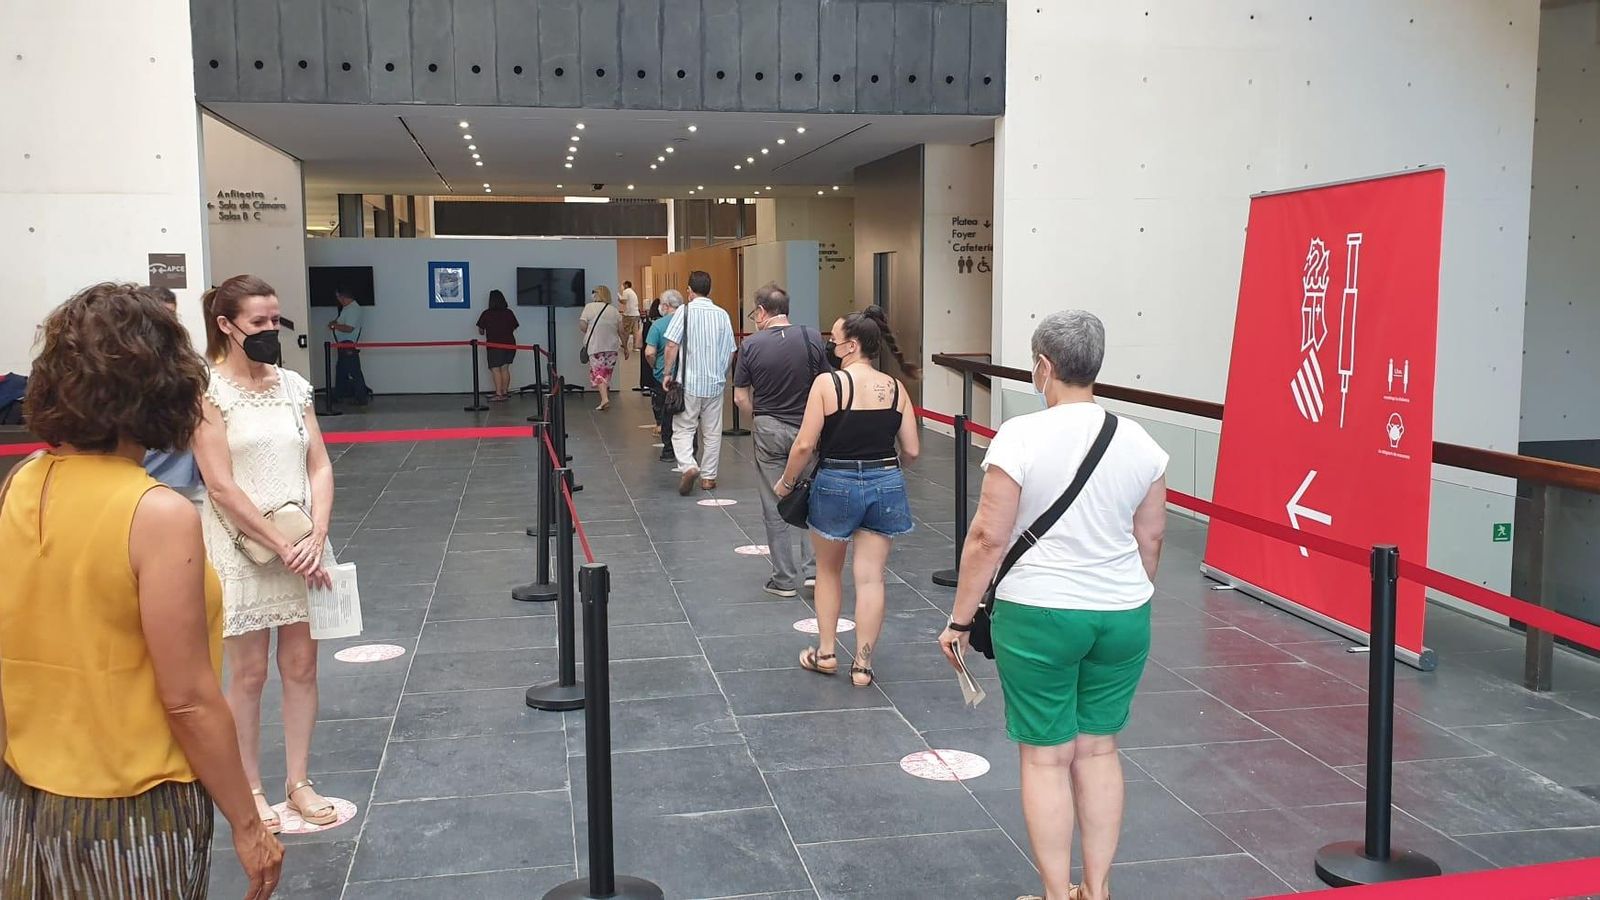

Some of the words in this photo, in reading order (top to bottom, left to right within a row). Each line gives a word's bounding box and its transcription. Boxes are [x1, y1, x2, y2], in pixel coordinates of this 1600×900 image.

[217, 189, 265, 199] Anfiteatro
[218, 200, 237, 210] Sala
[239, 200, 250, 210] de
[252, 200, 286, 210] Cámara
[218, 211, 241, 220] Salas
[242, 211, 249, 221] B
[253, 212, 261, 220] C
[952, 216, 978, 226] Platea
[952, 229, 976, 241] Foyer
[167, 265, 185, 273] APCE
